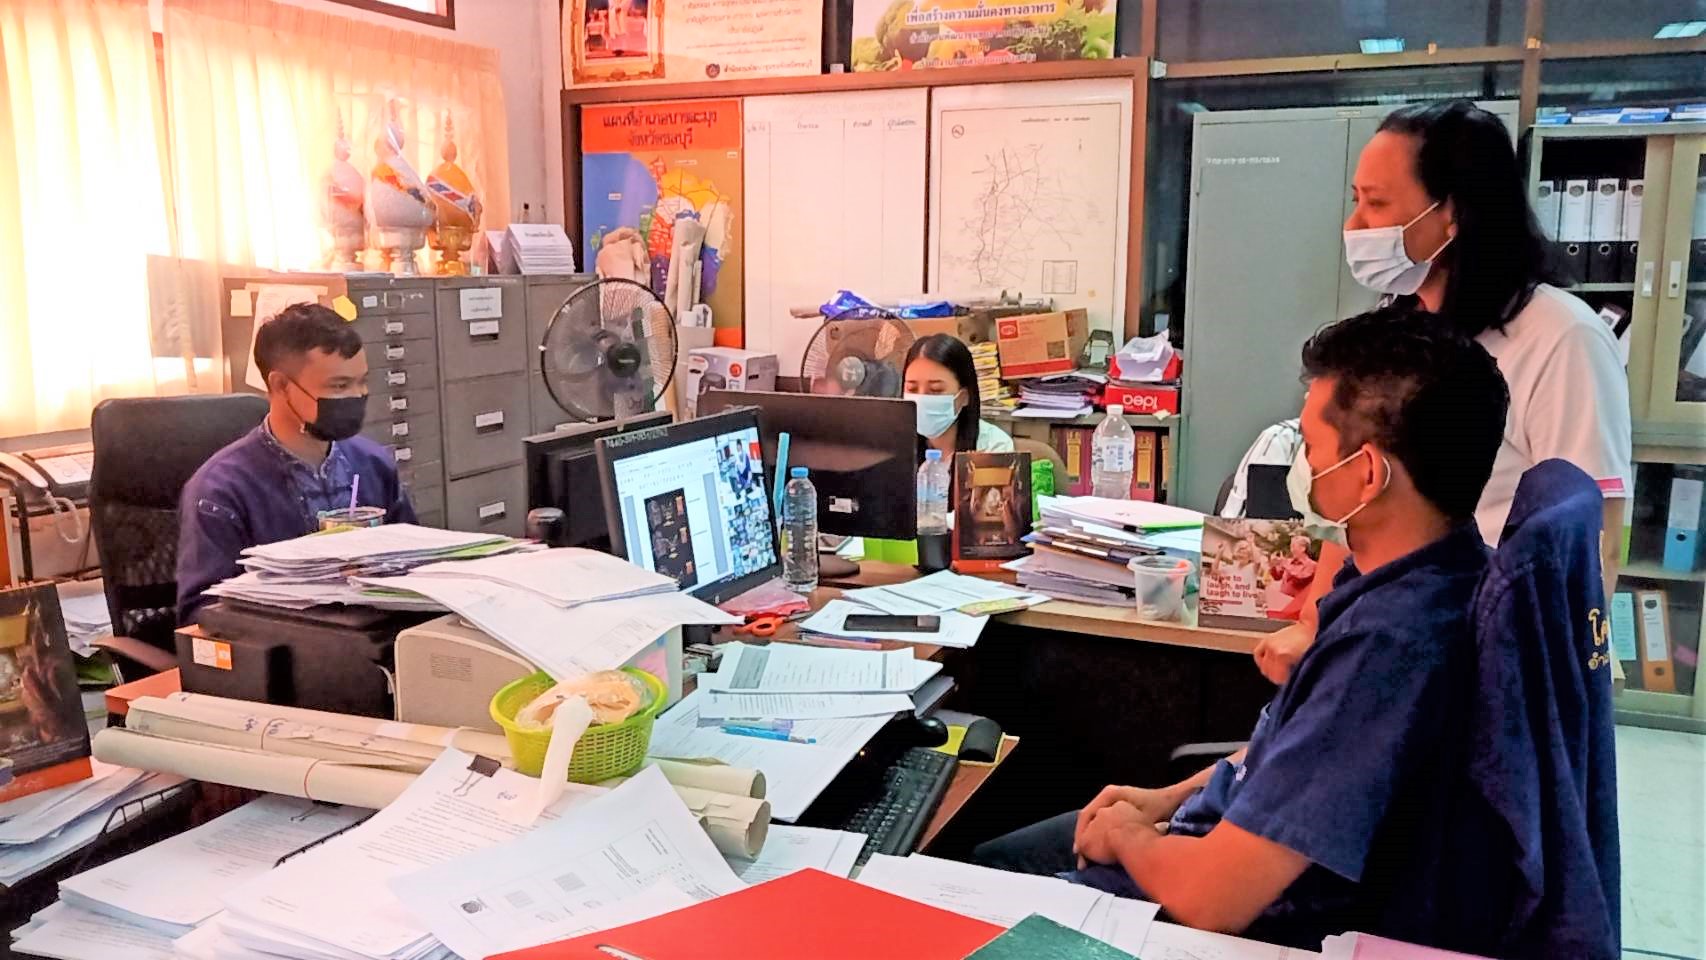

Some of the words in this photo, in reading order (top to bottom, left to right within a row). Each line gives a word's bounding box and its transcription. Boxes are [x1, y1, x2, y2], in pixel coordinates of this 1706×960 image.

[905, 1, 1056, 24] เพื่อสร้างความมั่นคงทางอาหาร
